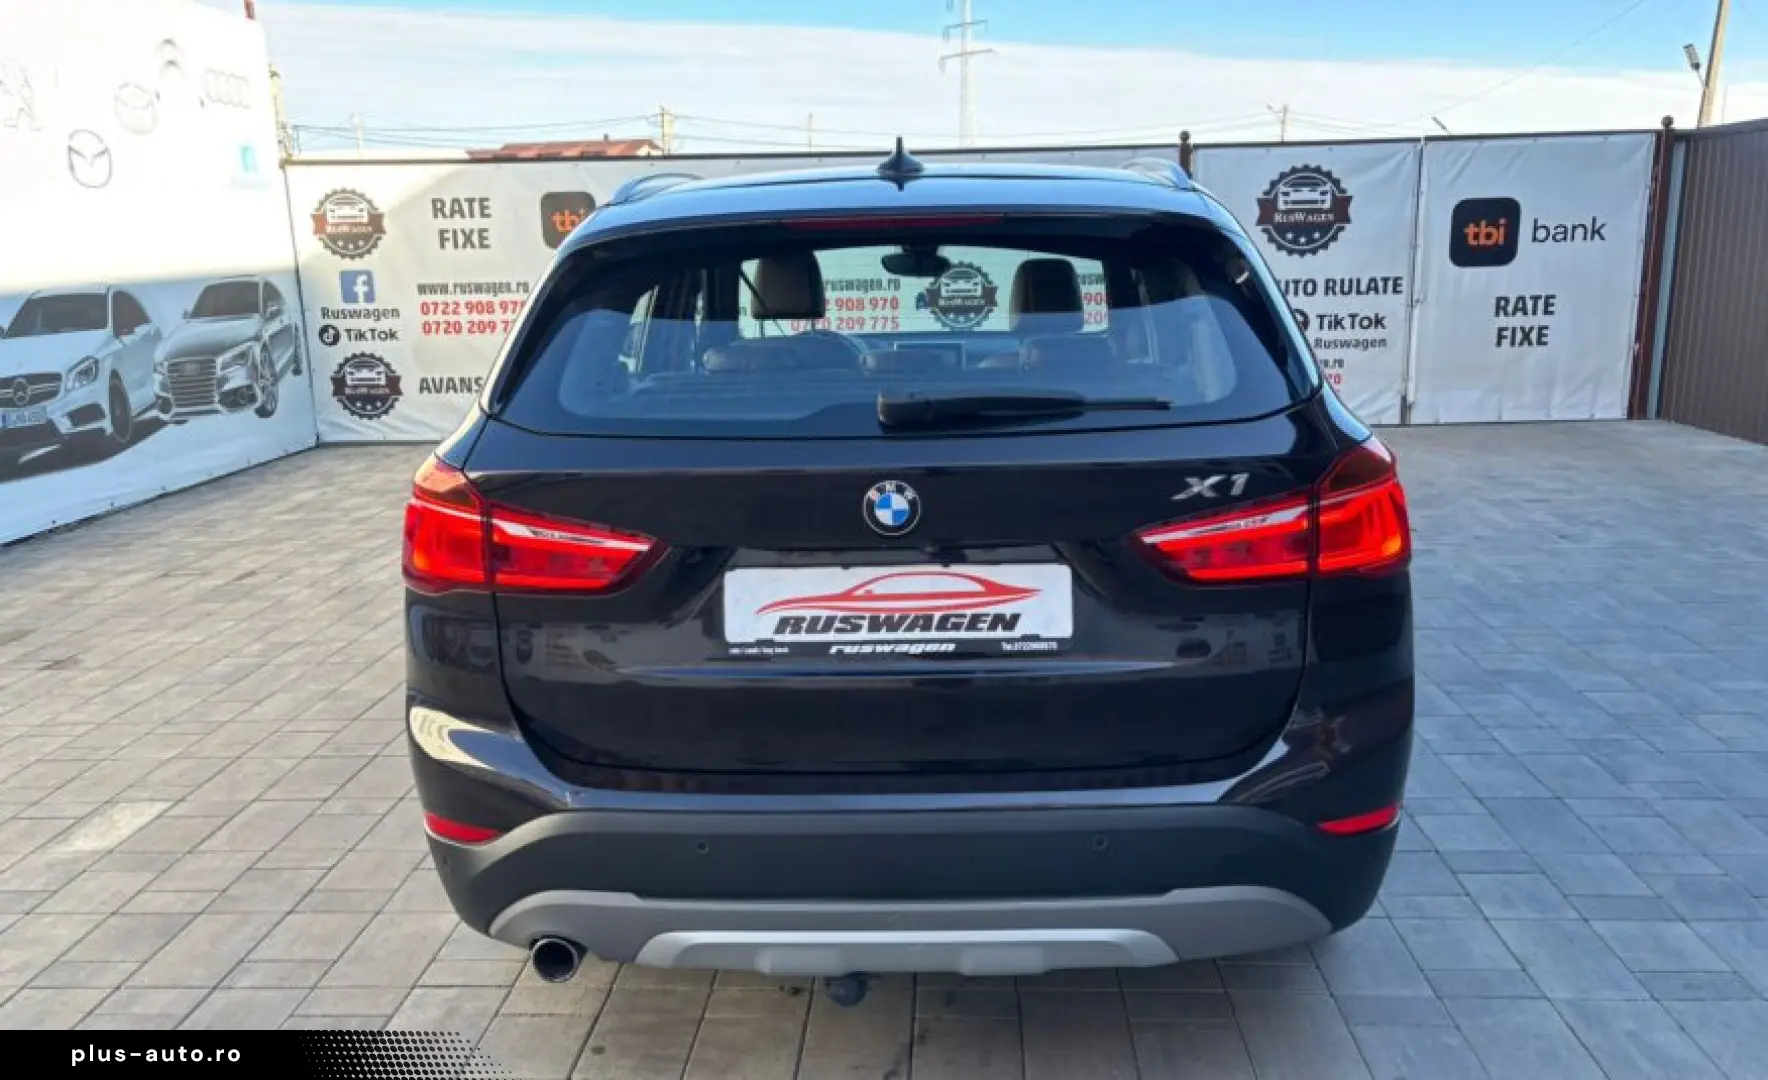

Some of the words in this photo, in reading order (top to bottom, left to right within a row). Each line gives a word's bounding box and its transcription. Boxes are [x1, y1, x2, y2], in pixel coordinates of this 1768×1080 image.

[431, 197, 493, 219] RATE
[438, 227, 491, 250] FIXE
[1464, 218, 1507, 246] tbi
[1531, 216, 1607, 243] bank
[417, 281, 530, 297] www.ruswagen.ro
[825, 278, 900, 294] ruswagen.ro
[1277, 278, 1318, 297] UTO
[1324, 276, 1403, 296] RULATE
[421, 301, 460, 316] 0722
[464, 300, 495, 315] 908
[836, 297, 865, 312] 908
[870, 297, 899, 311] 970
[1494, 294, 1556, 318] RATE
[320, 306, 400, 322] Ruswagen
[1316, 312, 1387, 331] TikTok
[422, 321, 462, 335] 0720
[467, 320, 497, 334] 209
[837, 316, 865, 330] 209
[870, 316, 899, 330] 775
[344, 328, 400, 343] TikTok
[1494, 324, 1549, 348] FIXE
[1314, 337, 1387, 352] Ruswagen
[419, 376, 486, 395] AVANS
[1172, 473, 1250, 500] X1
[773, 613, 1022, 635] RUSWAGEN
[828, 641, 956, 655] ruswagen
